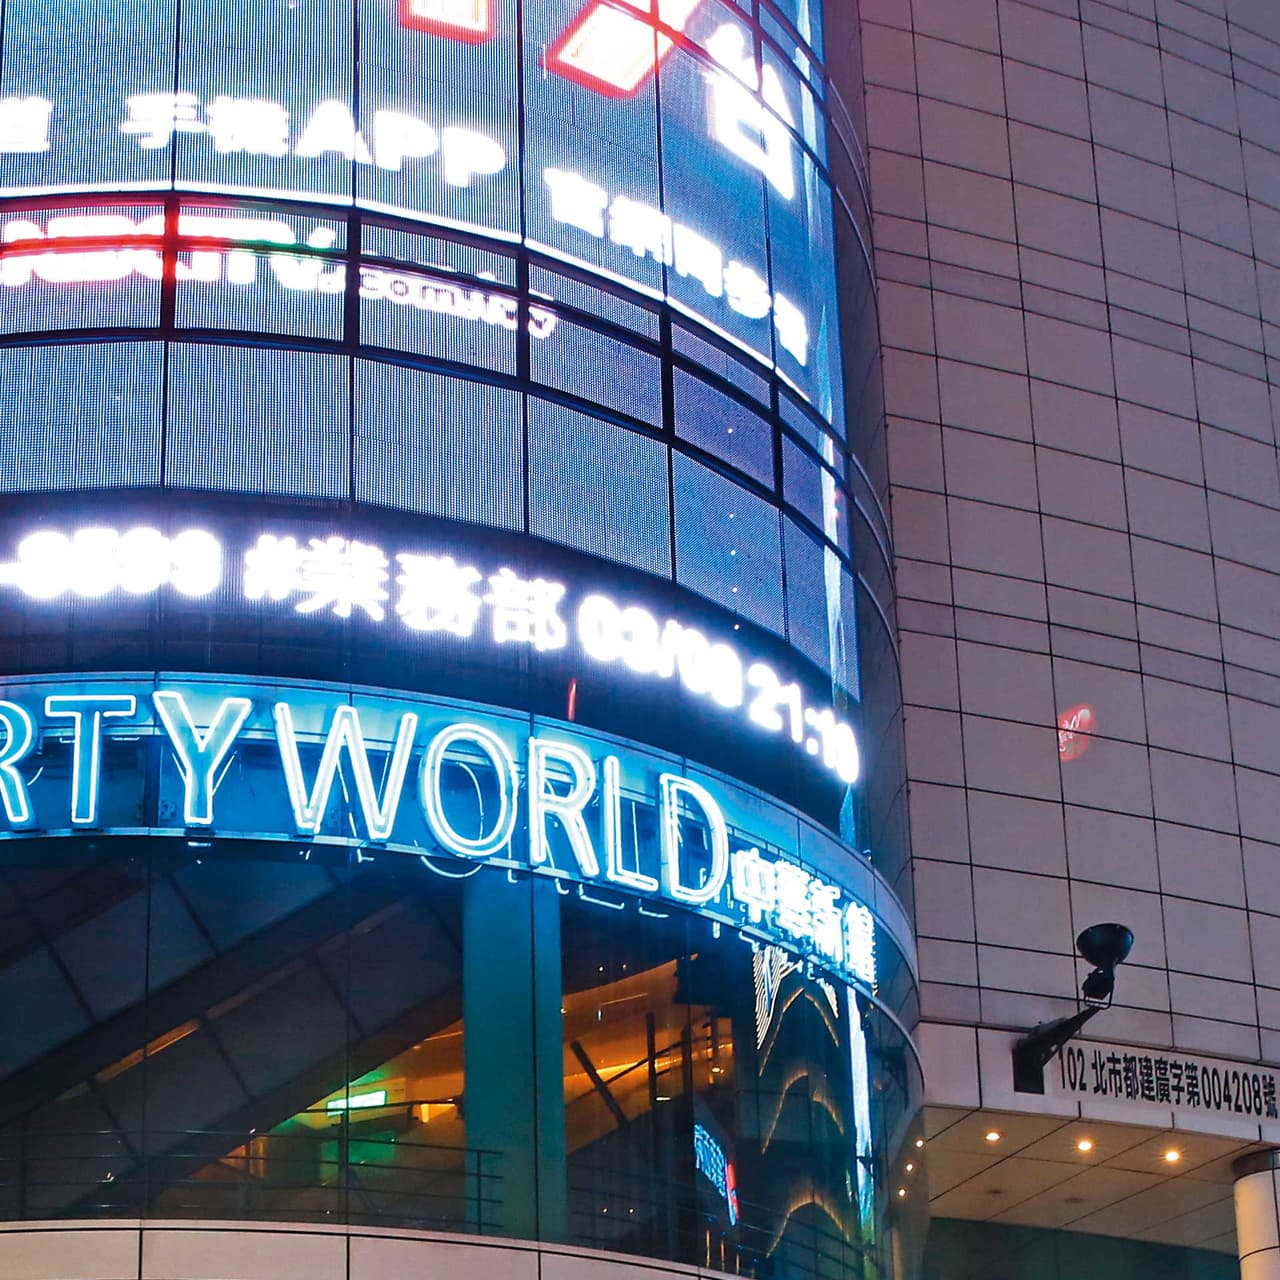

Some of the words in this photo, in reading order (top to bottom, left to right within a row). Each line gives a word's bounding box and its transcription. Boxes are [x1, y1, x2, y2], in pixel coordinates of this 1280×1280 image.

[1058, 1047, 1087, 1092] 102
[1091, 1049, 1278, 1119] 北市都建廣字第004208號
